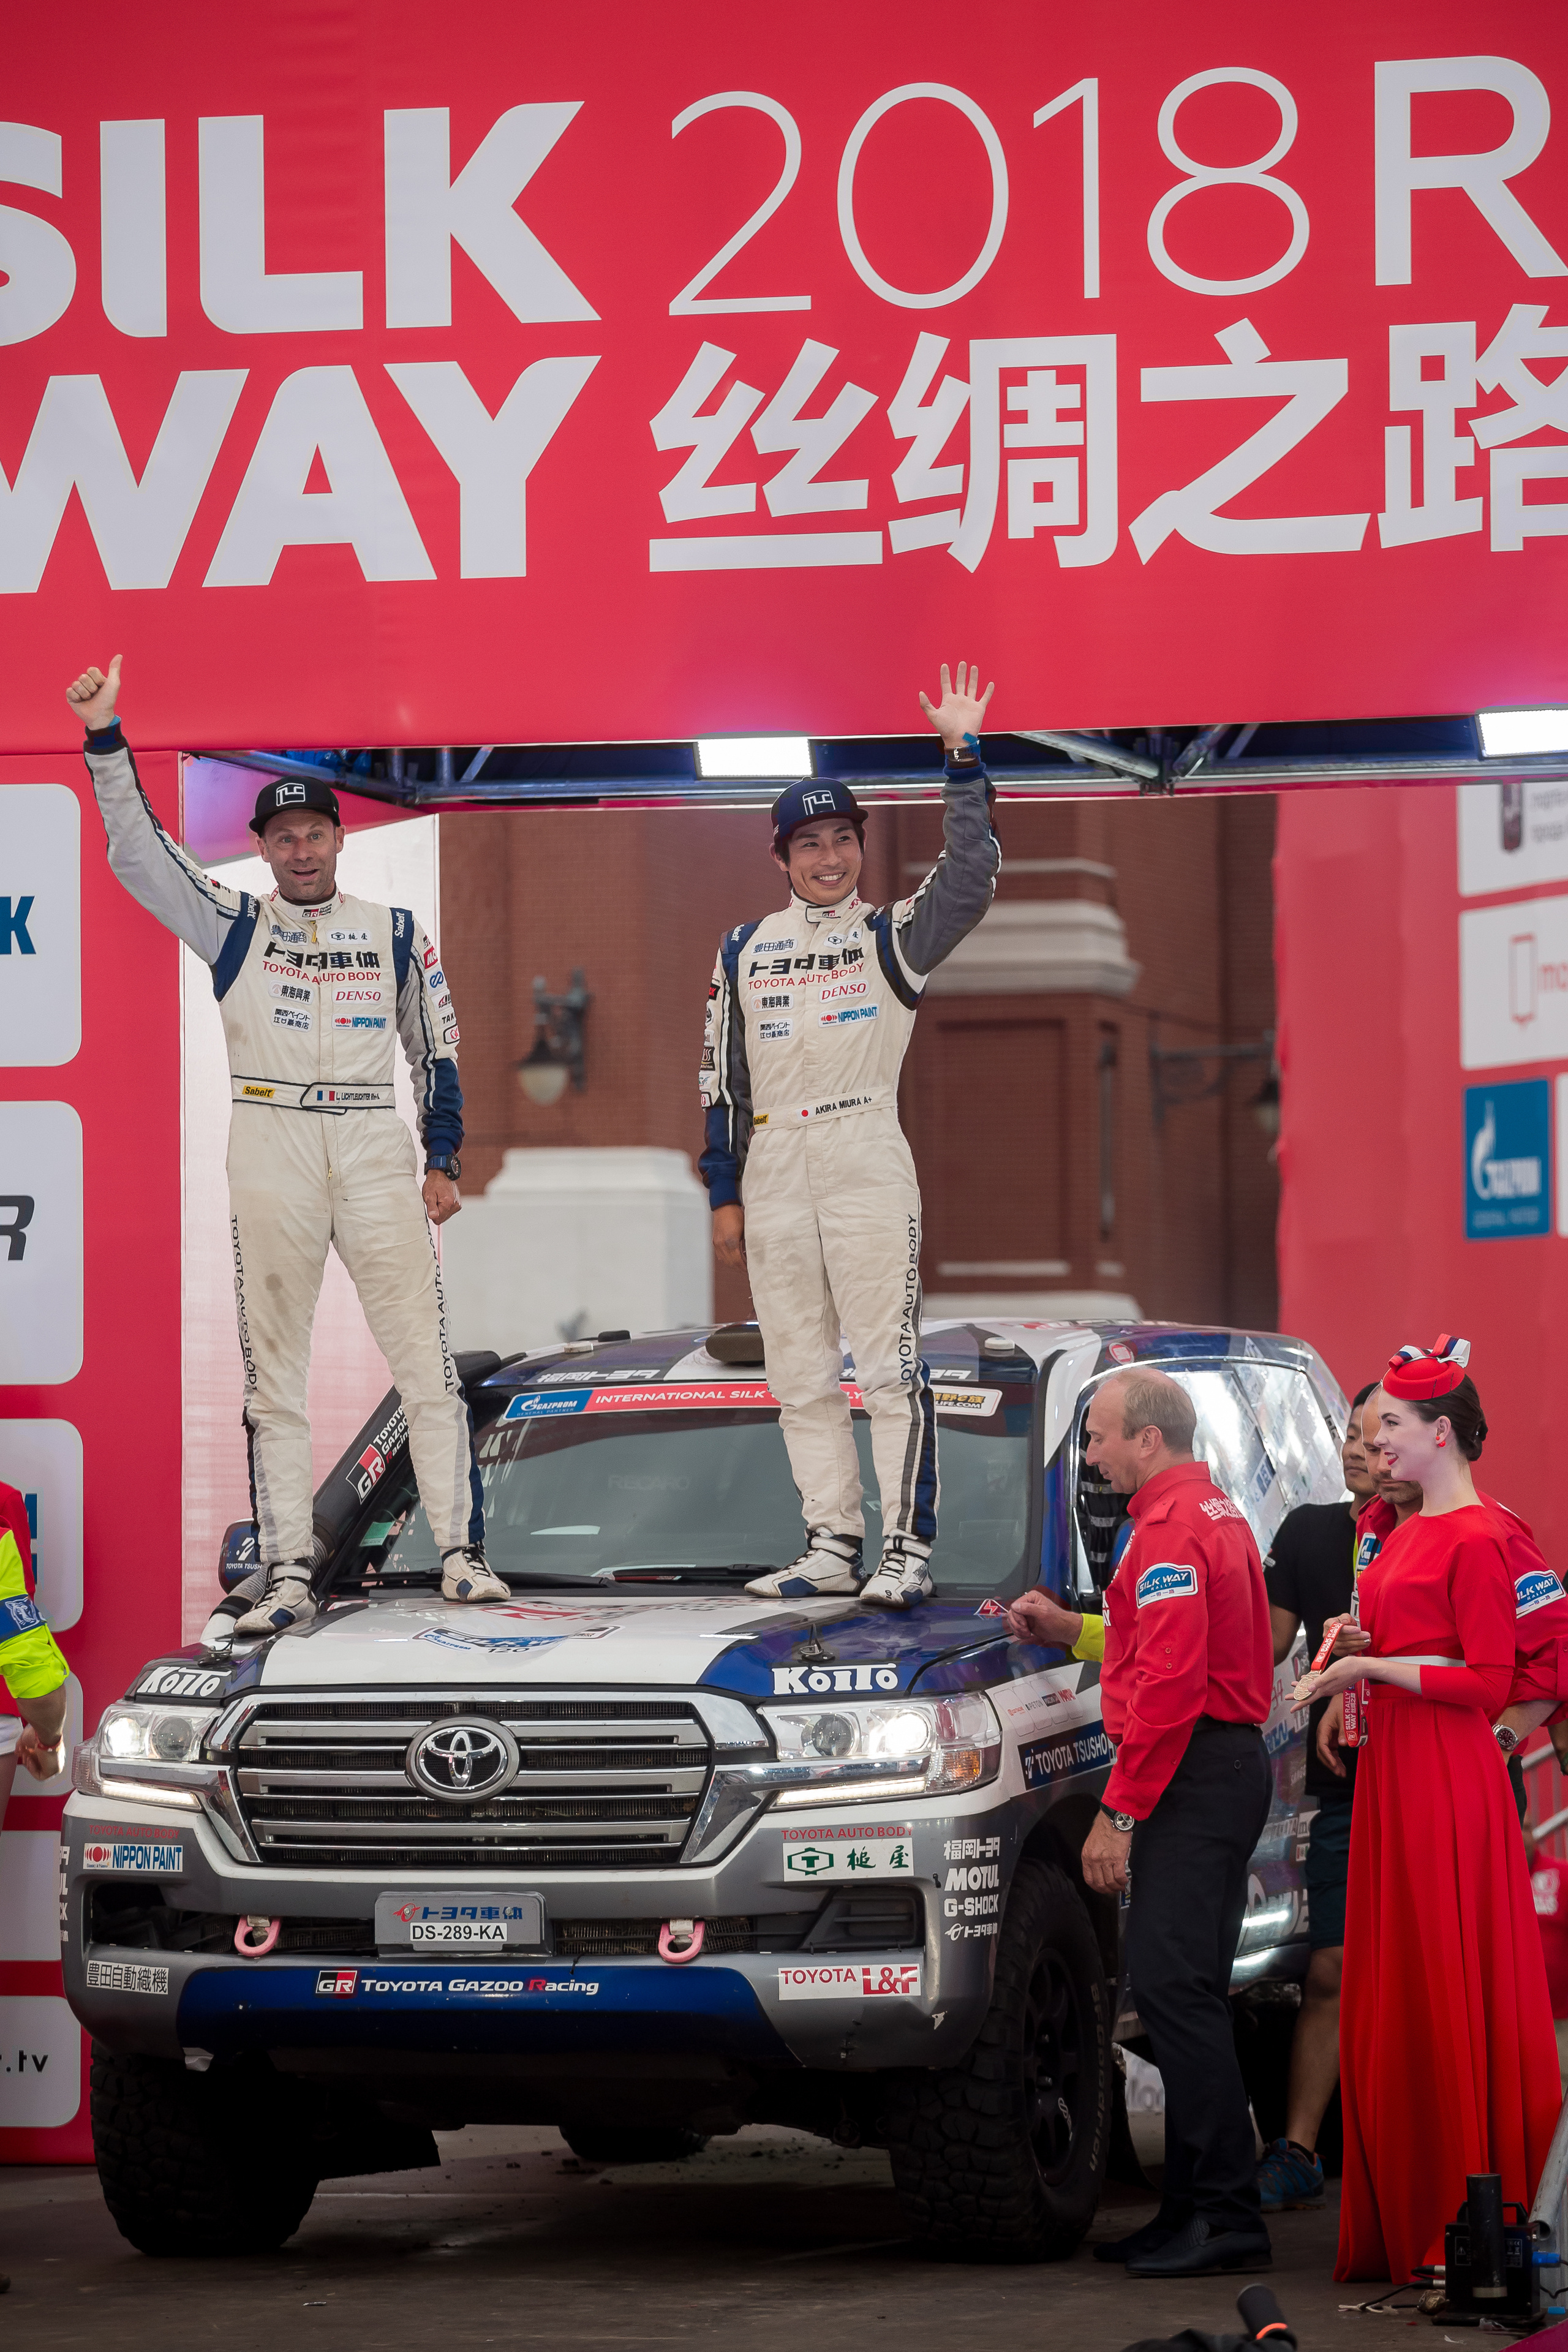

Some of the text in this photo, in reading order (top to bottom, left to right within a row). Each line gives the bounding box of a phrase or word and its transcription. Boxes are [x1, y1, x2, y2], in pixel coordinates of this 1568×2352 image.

[669, 55, 1568, 316] 2018 R
[0, 100, 603, 347] SILK
[649, 303, 1568, 575] 丝绸之路
[0, 355, 603, 595] WAY
[263, 941, 381, 972] トヨタ車体
[748, 946, 865, 978] トヨタ車体
[262, 960, 382, 986] TOYOTA AUTO BODY
[748, 962, 864, 990] TOYOTA AUTO BODY
[280, 984, 311, 1003] 東海興業
[336, 990, 381, 1001] DENSO
[761, 995, 790, 1009] 東海興業
[821, 982, 867, 1000] DENSO
[352, 1017, 387, 1029] NIPPON PAINT
[837, 1006, 878, 1023] NIPPON PAINT
[244, 1087, 273, 1098] Sabelt
[815, 1096, 873, 1115] AKIRA MIURA A+
[231, 1214, 244, 1290] TOYOTA
[239, 1292, 250, 1343] AUTO
[899, 1213, 918, 1385] TOYOTA AUTO BODY
[435, 1264, 454, 1392] TOYOTA AUTO
[536, 1400, 578, 1411] GAZPROM
[595, 1390, 726, 1404] INTERNATIONAL
[729, 1390, 766, 1400] SILK
[372, 1404, 403, 1446] TOYOTA
[381, 1415, 408, 1455] GAZOO
[357, 1455, 385, 1499] GR
[1139, 1572, 1189, 1593] SILK WAY
[1151, 1583, 1172, 1591] RALLY
[1516, 1577, 1553, 1600] ILK WAY
[1320, 1637, 1332, 1653] SILK
[1324, 1639, 1333, 1652] WAY
[1035, 1744, 1074, 1775] TOYOTA
[1073, 1732, 1109, 1763] TSUSHO
[89, 1824, 180, 1839] TOYOTA AUTO BODY
[781, 1825, 914, 1841] TOYOTA AUTO BODY
[112, 1844, 182, 1871] NIPPON PAINT
[943, 1837, 1001, 1860] 福岡トヨタ
[944, 1864, 1000, 1891] MOTUL
[422, 1905, 523, 1920] トヨタ車体
[944, 1894, 999, 1918] G-SHOCK
[411, 1924, 505, 1940] DS-289-KA
[964, 1922, 998, 1938] トヨタ車体
[87, 1961, 168, 1994] 豊田自動織機
[318, 1979, 354, 1992] GR
[529, 1978, 600, 1996] Racing
[780, 1966, 918, 1996] TOYOTA L&F
[0, 2049, 49, 2073] .tv
